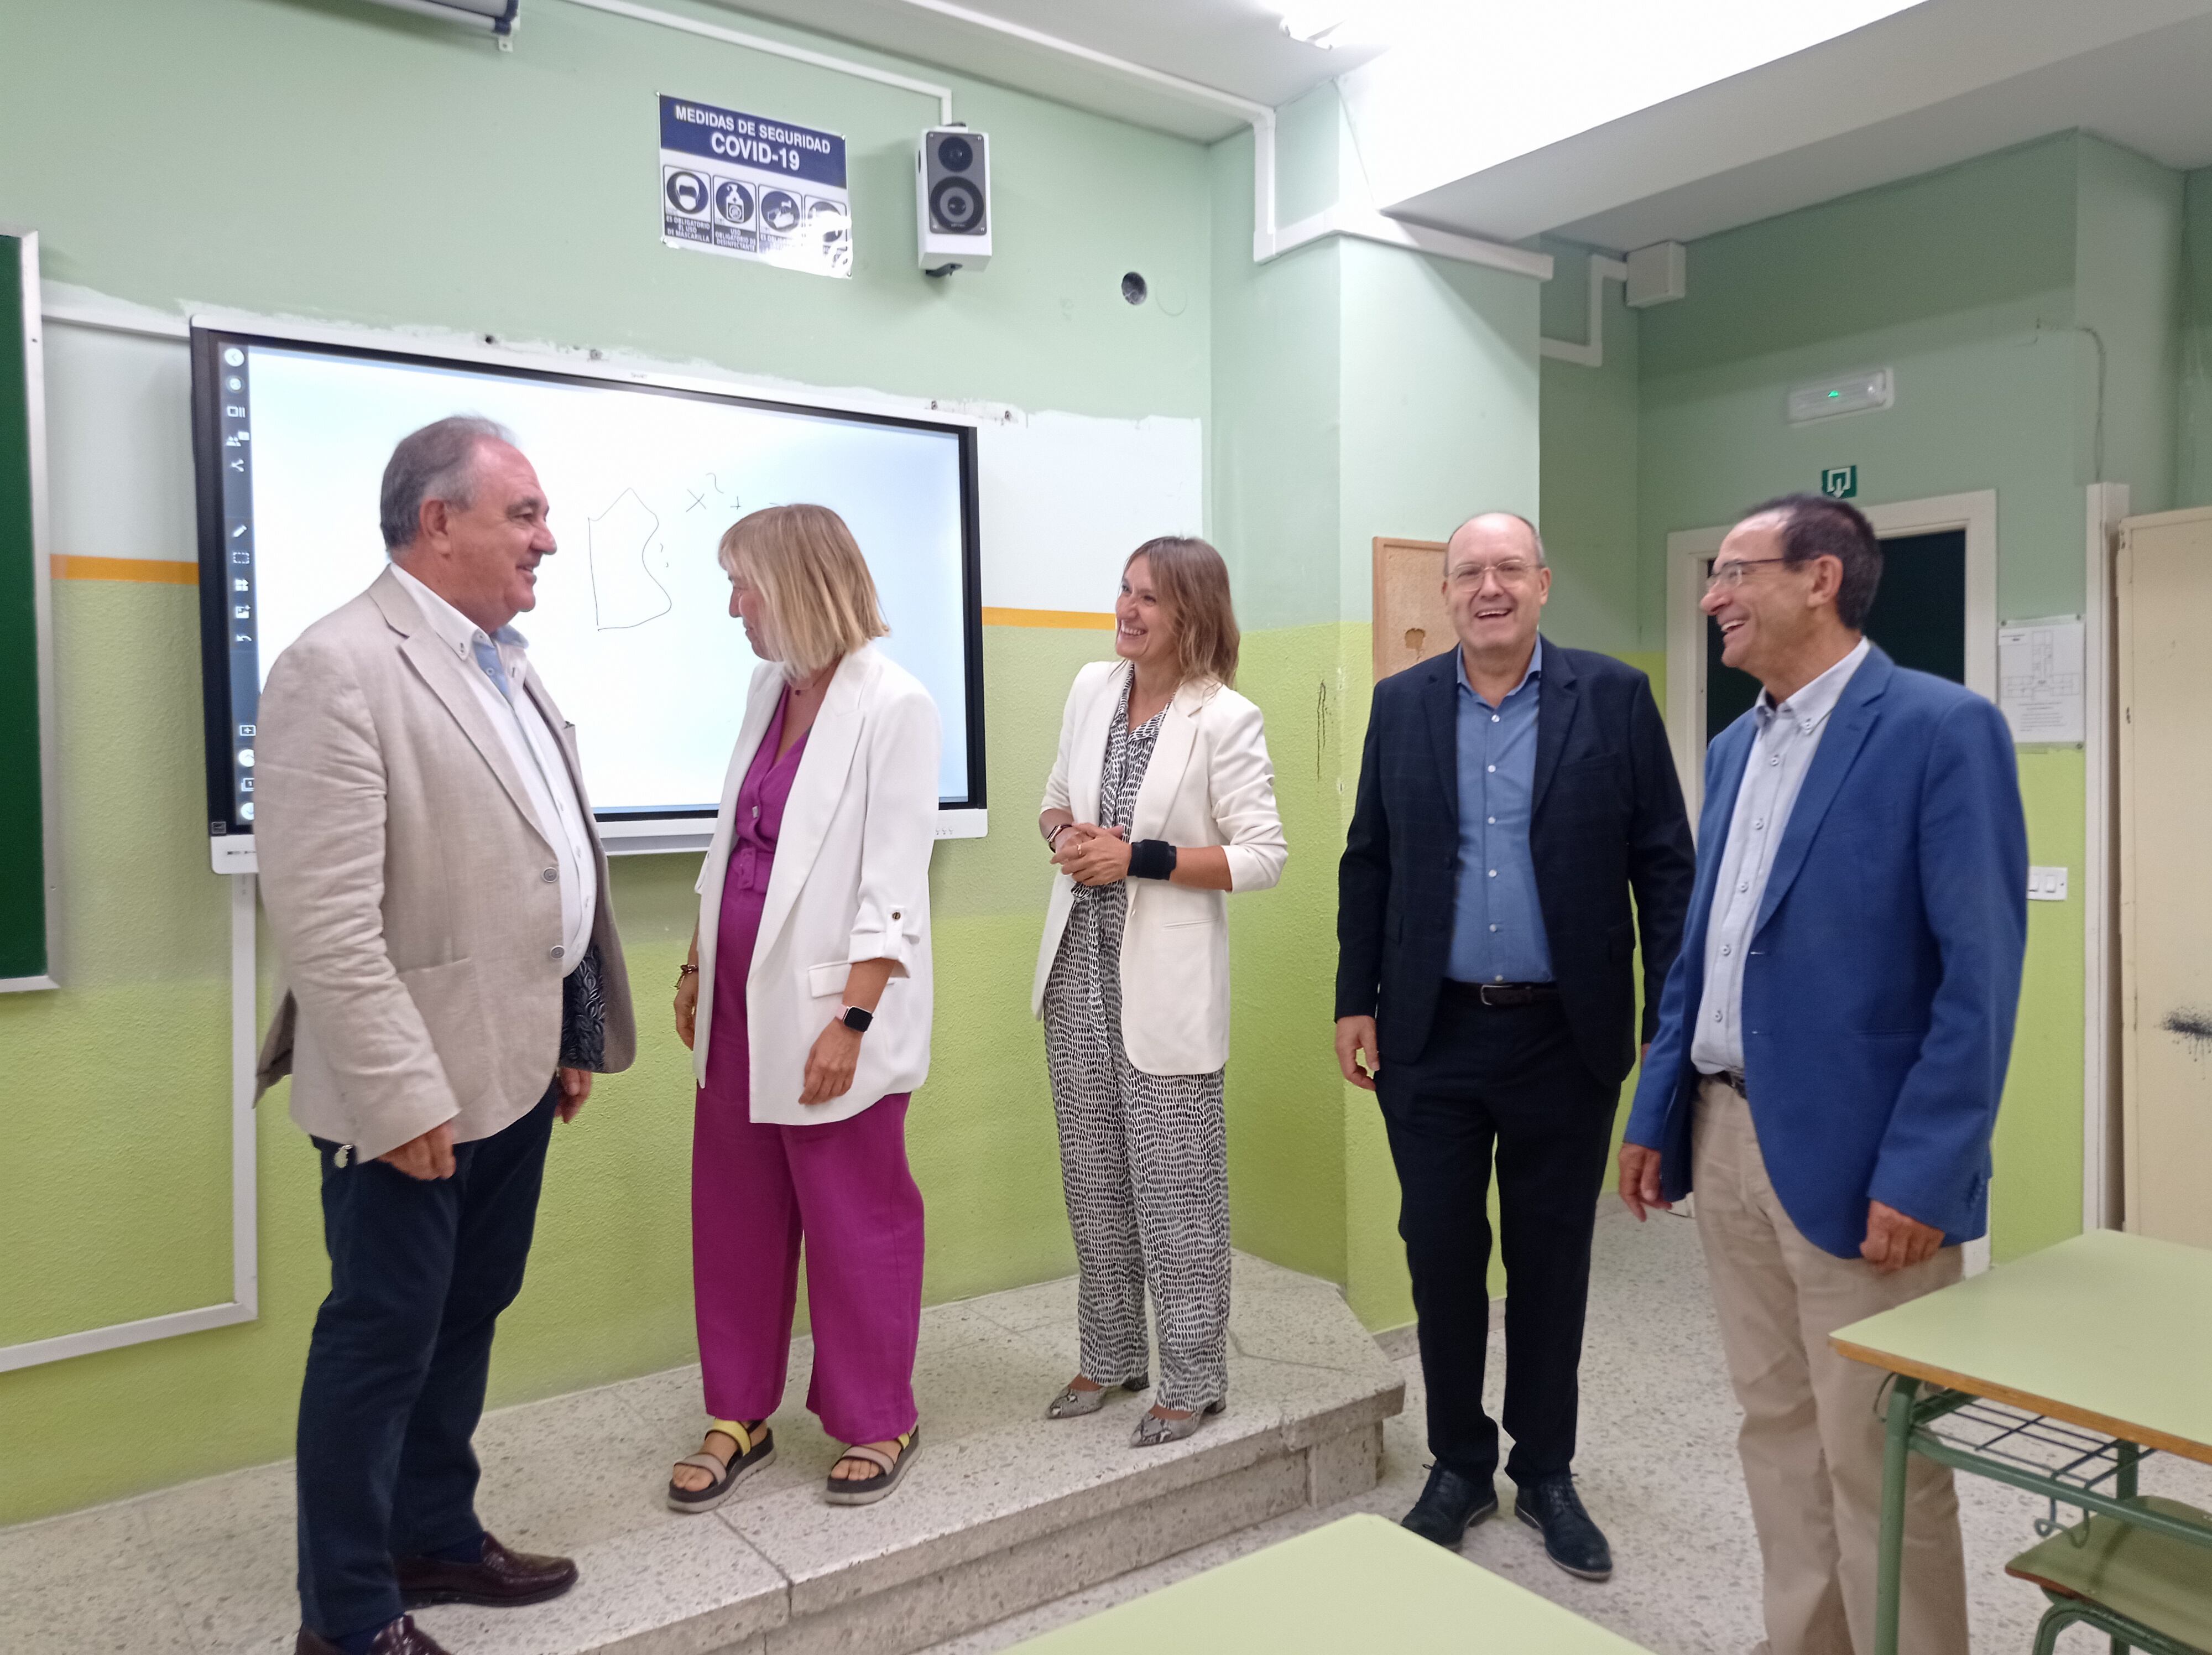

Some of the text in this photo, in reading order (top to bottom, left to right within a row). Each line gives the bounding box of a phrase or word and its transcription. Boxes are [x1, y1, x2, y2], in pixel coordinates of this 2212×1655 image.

[675, 105, 831, 154] MEDIDAS DE SEGURIDAD
[711, 132, 800, 171] COVID-19
[674, 217, 710, 230] OBLIGATORIO
[675, 230, 710, 243] MASCARILLA
[715, 231, 748, 243] OBLIGATORIO
[717, 238, 755, 252] DESINFECTANTE
